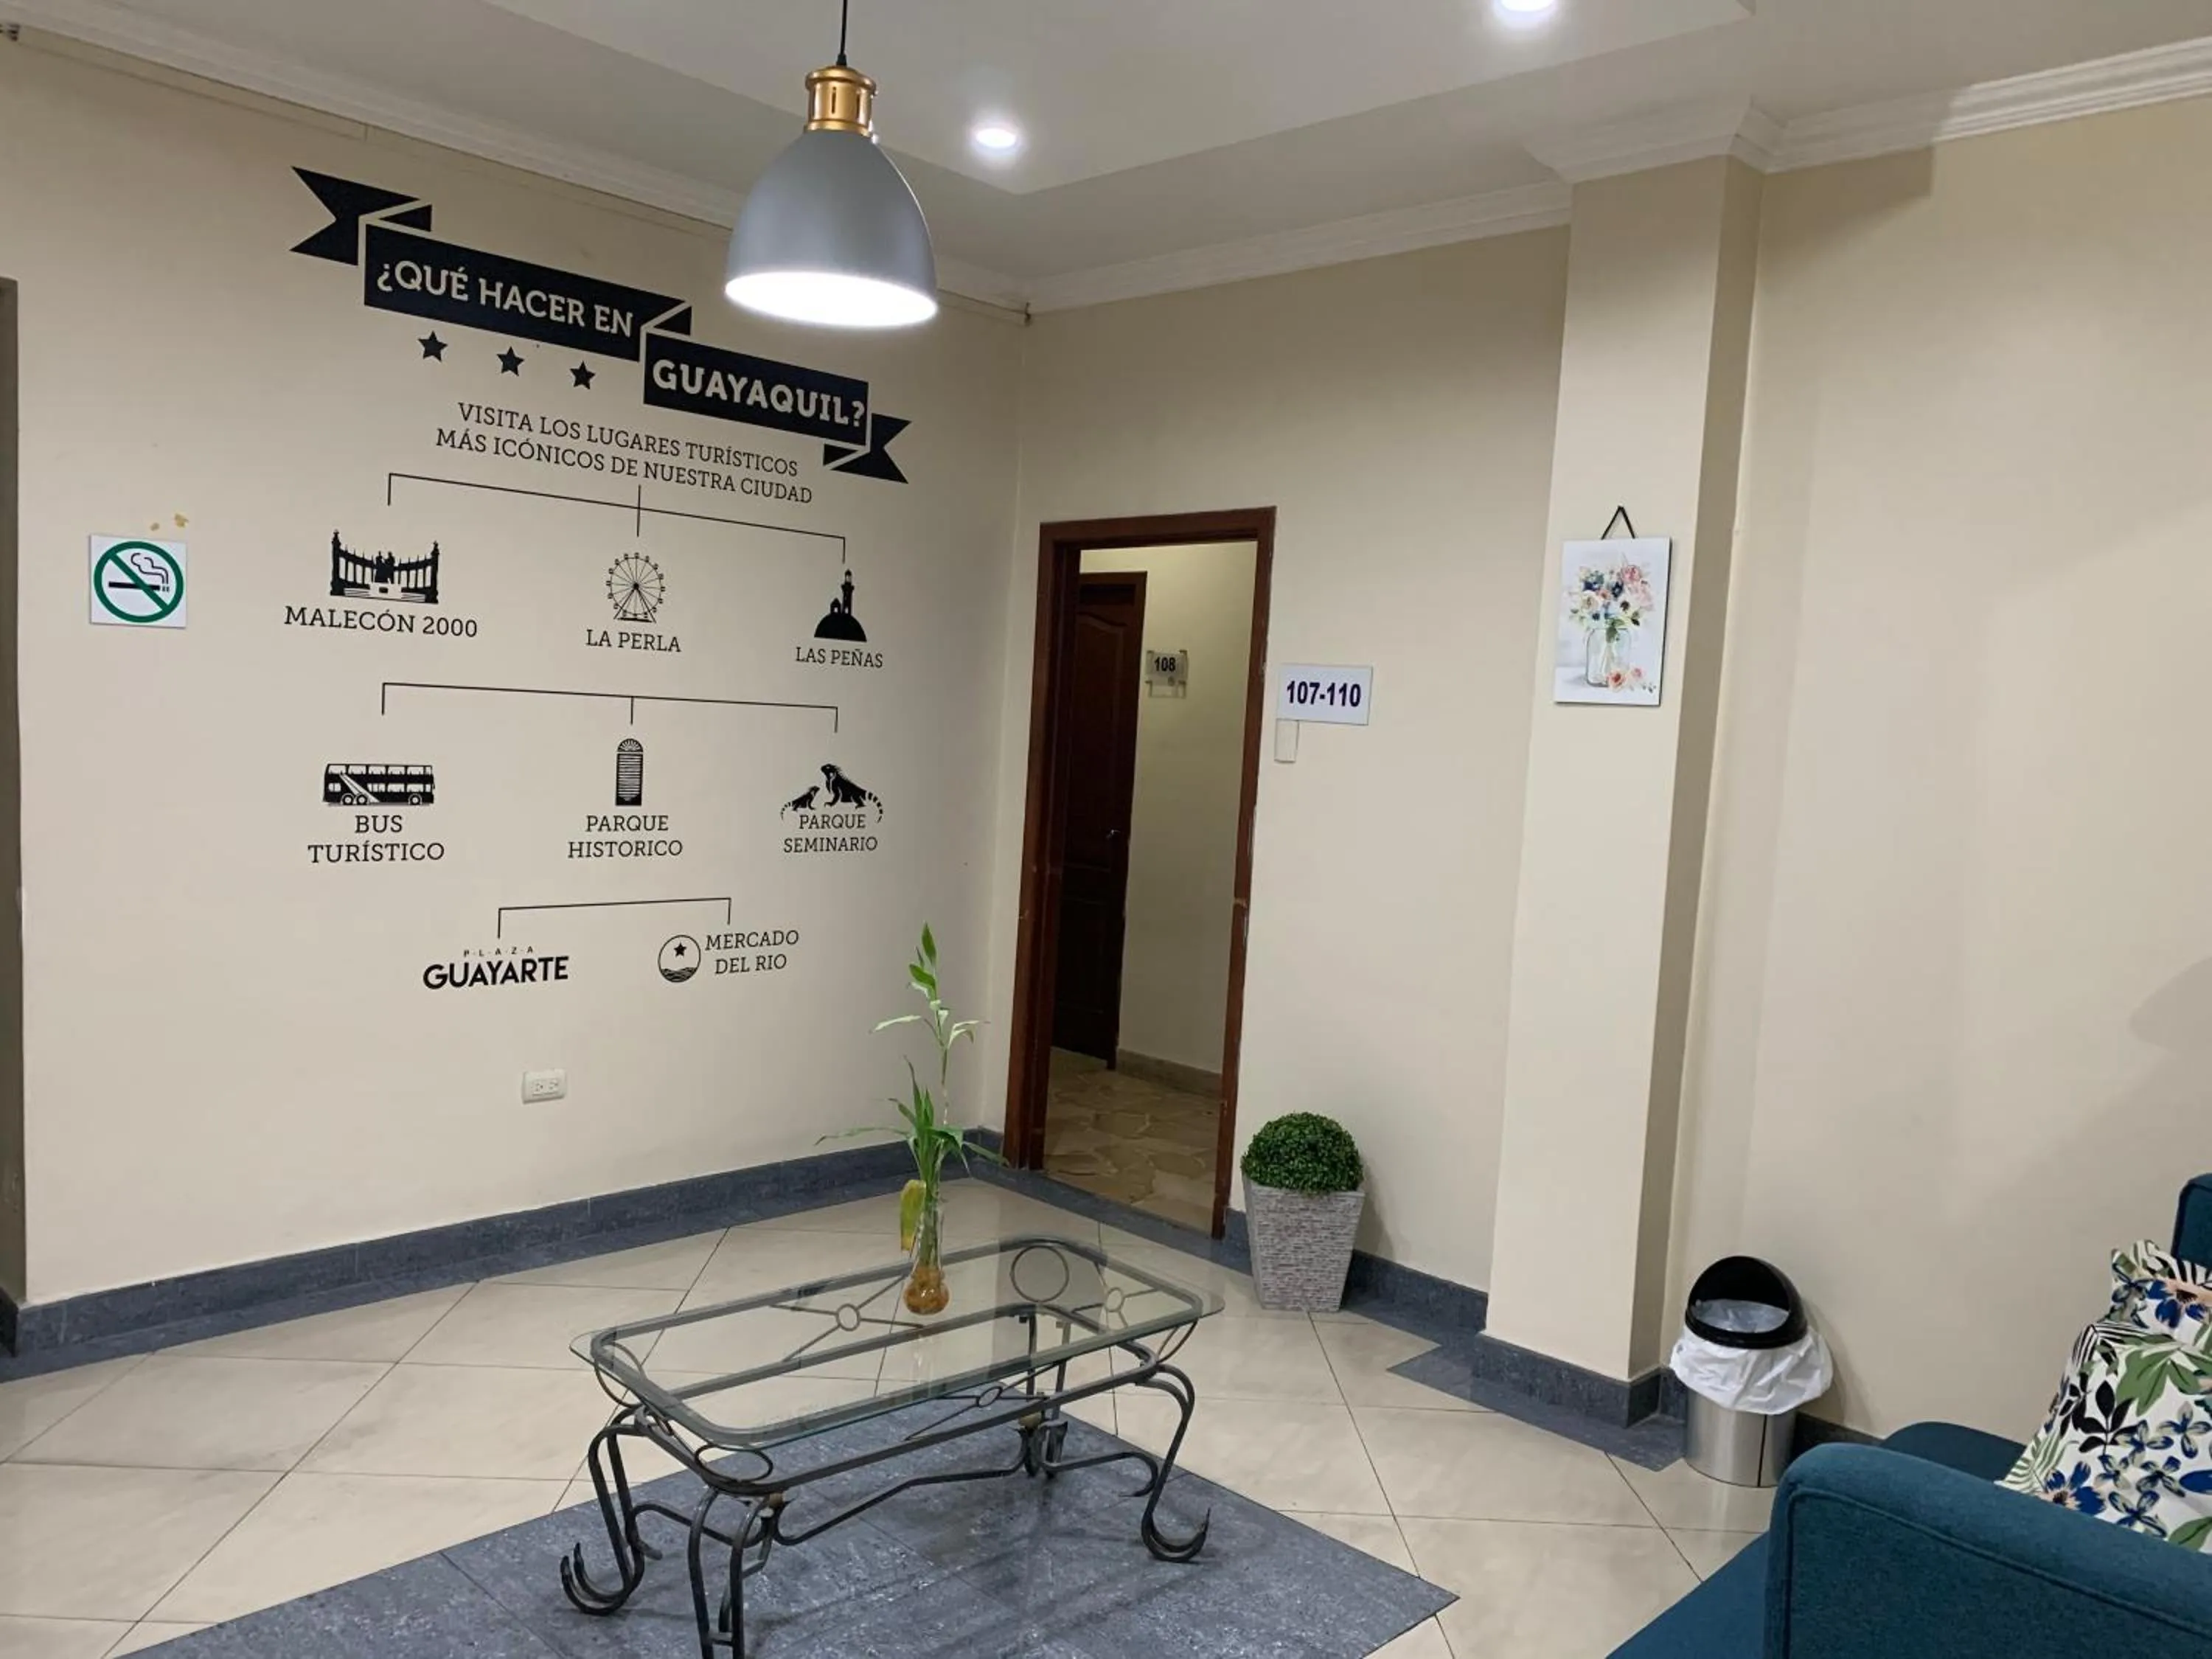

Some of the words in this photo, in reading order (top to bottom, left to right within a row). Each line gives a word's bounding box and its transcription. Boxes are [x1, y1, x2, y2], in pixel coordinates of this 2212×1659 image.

[377, 260, 468, 302] ¿QUÉ
[479, 277, 585, 327] HACER
[594, 305, 633, 338] EN
[651, 358, 866, 429] GUAYAQUIL?
[458, 402, 533, 433] VISITA
[540, 416, 580, 440] LOS
[586, 424, 682, 457] LUGARES
[685, 439, 799, 479] TURÍSTICOS
[435, 425, 487, 453] MÁS
[493, 434, 605, 473] ICÓNICOS
[611, 452, 639, 477] DE
[642, 460, 737, 493] NUESTRA
[740, 477, 813, 504] CIUDAD
[284, 605, 416, 633] MALECÓN
[422, 616, 477, 638] 2000
[586, 629, 612, 647] LA
[618, 631, 681, 653] PERLA
[796, 647, 827, 664] LAS
[830, 648, 883, 669] PEÑAS
[1154, 657, 1176, 673] 108
[1287, 681, 1361, 707] 107-110
[355, 815, 403, 834] BUS
[586, 815, 669, 832] PARQUE
[799, 813, 866, 830] PARQUE
[307, 840, 445, 863] TURÍSTICO
[568, 840, 684, 858] HISTORICO
[783, 836, 878, 853] SEMINARIO
[705, 930, 799, 951] MERCADO
[422, 956, 569, 990] GUAYARTE
[714, 956, 750, 975] DEL
[755, 953, 787, 971] RIO
